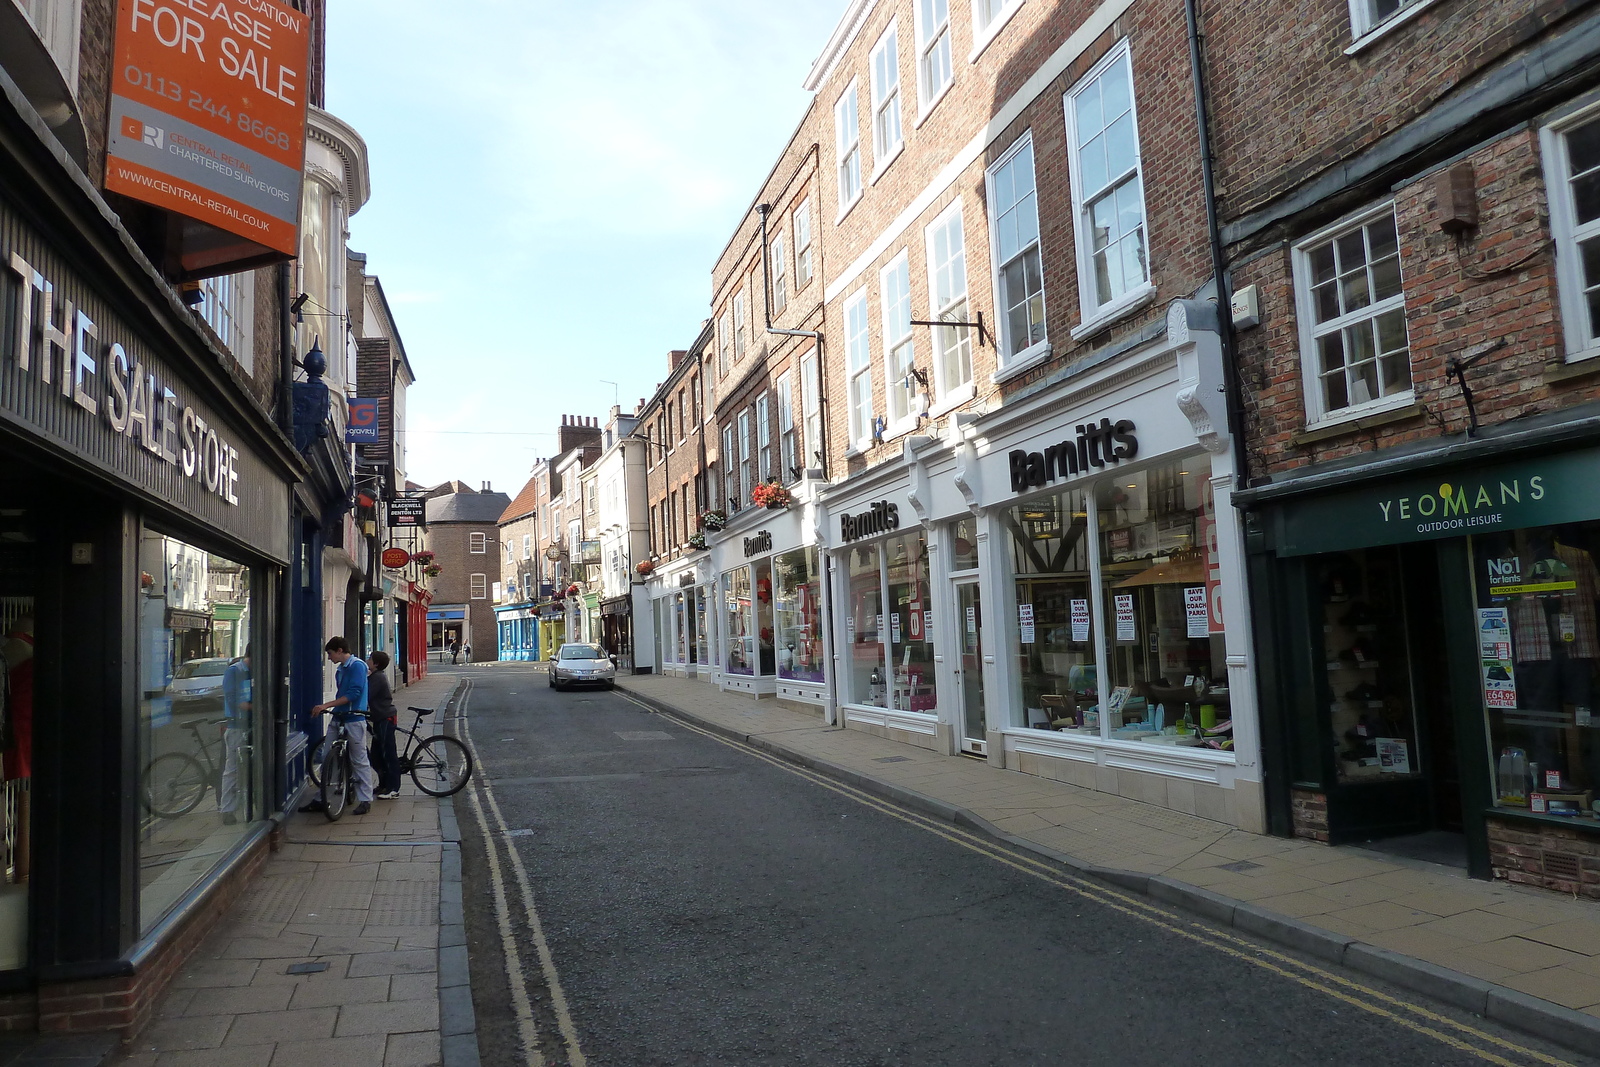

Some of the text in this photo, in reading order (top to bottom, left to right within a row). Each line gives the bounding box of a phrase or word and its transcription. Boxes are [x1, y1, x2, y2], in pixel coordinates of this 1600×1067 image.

[173, 0, 272, 49] EASE
[237, 0, 299, 33] CATION
[131, 0, 297, 107] FOR SALE
[125, 65, 291, 151] 0113 244 8668
[169, 144, 291, 203] CHARTERED SURVEYORS
[170, 132, 254, 175] CENTRAL RETAIL
[118, 167, 270, 234] WWW.CENTRAL-RETAIL.CO.UK
[10, 251, 238, 506] THE SALE STORE
[1009, 418, 1138, 493] Barnitts
[1379, 475, 1545, 522] YEOMANS
[743, 530, 773, 558] Barnitts
[840, 500, 900, 543] Barnitts
[1417, 513, 1503, 534] OUTDOOR LEISURE
[1487, 557, 1520, 576] No.1
[1490, 574, 1521, 584] for tents
[1487, 690, 1515, 700] £64.95
